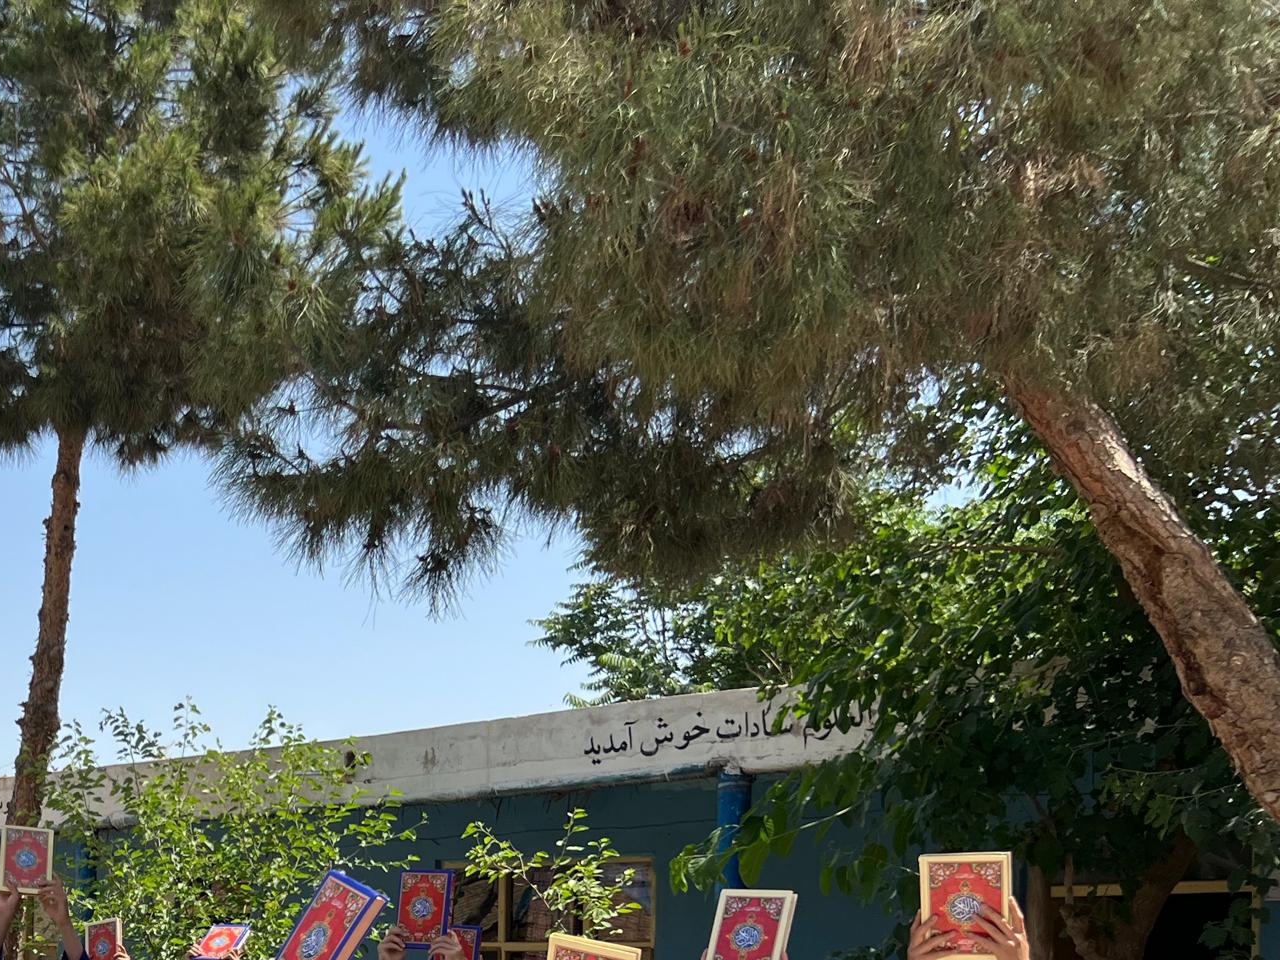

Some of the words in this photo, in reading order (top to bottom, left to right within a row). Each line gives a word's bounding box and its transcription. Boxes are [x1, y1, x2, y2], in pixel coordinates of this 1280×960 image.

[583, 719, 639, 764] آمدید
[639, 711, 710, 756] خوش
[716, 709, 793, 739] سادات
